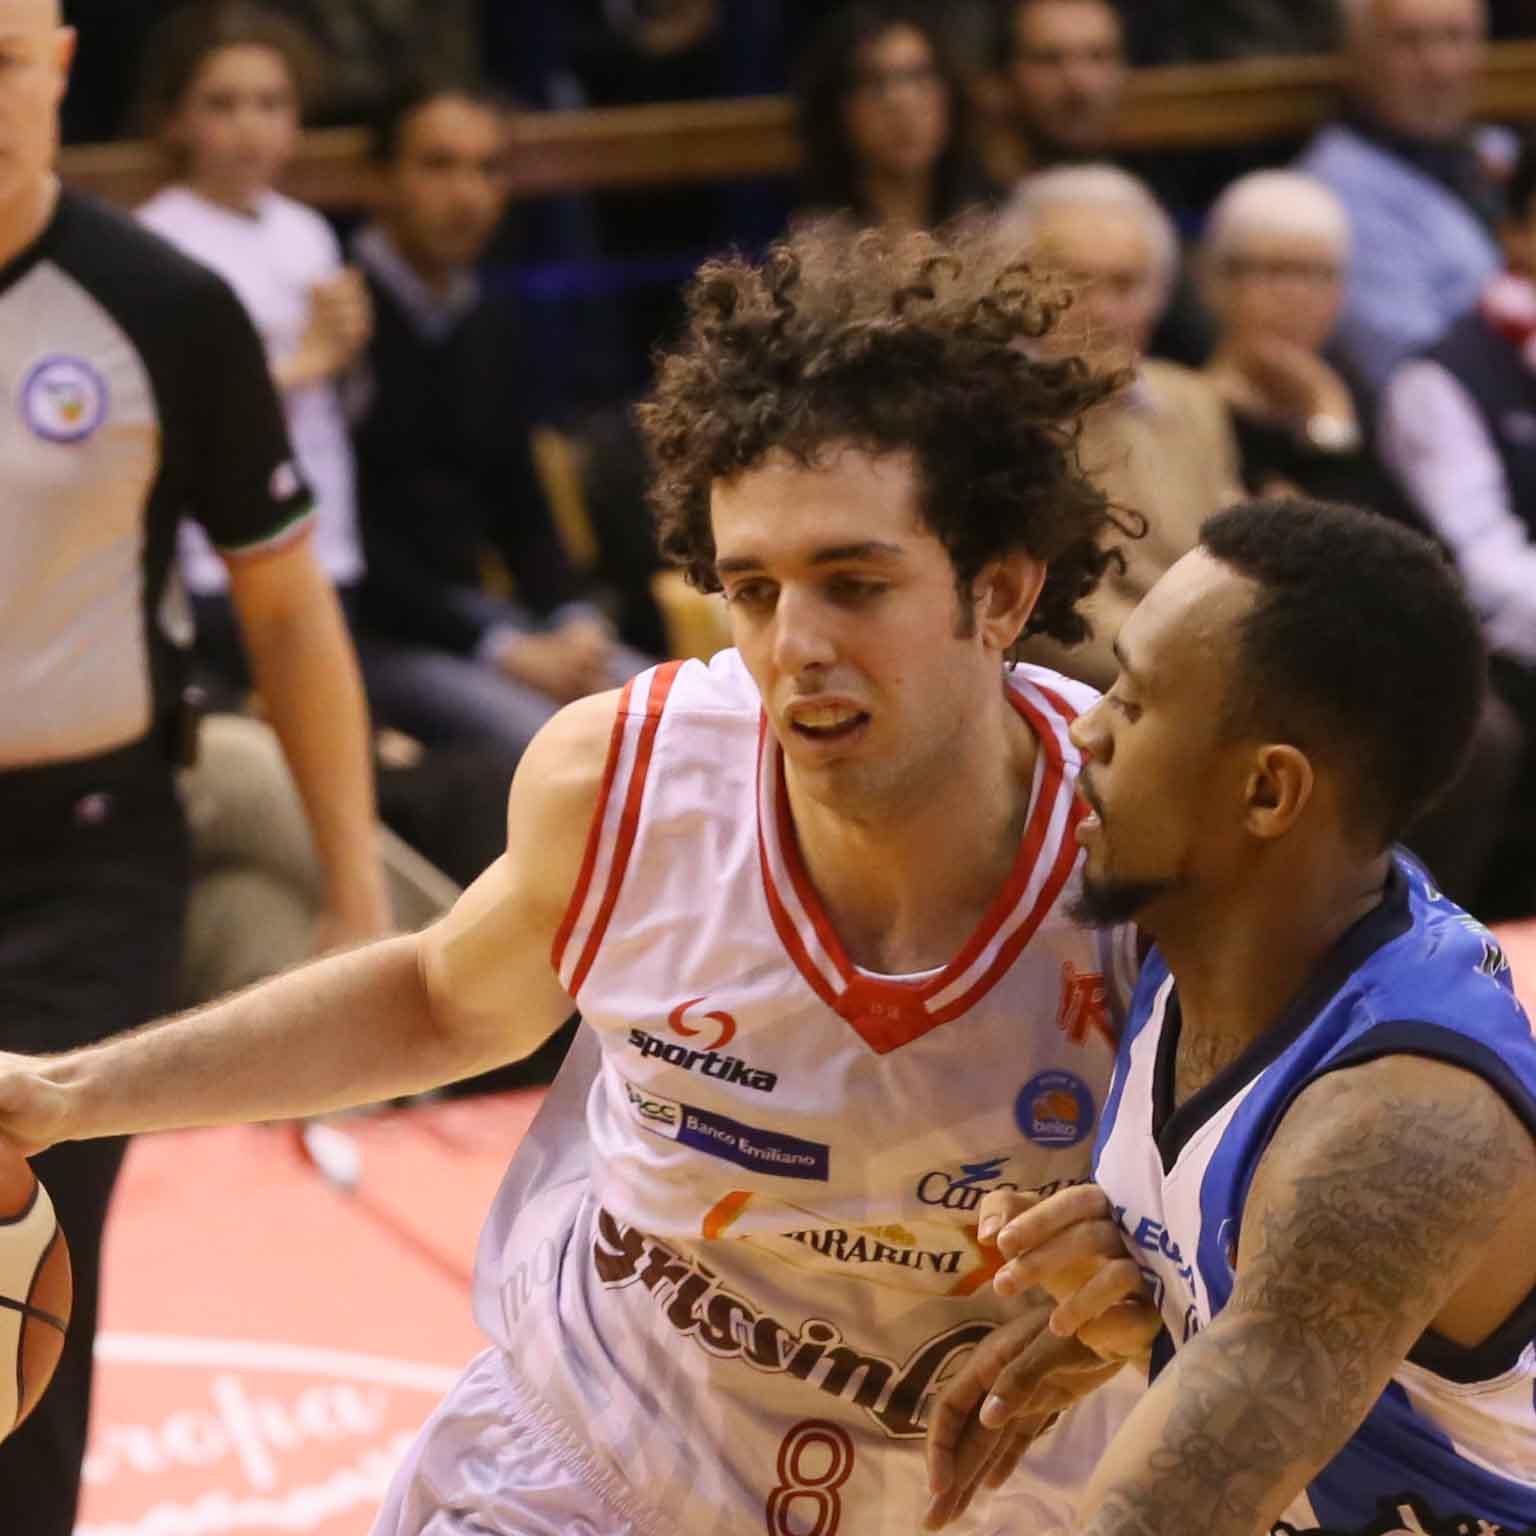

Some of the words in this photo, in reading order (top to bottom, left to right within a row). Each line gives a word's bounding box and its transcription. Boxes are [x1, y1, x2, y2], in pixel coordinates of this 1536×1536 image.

[628, 1027, 778, 1093] sportika
[686, 1114, 736, 1146] Banco
[738, 1138, 816, 1167] Emiliano
